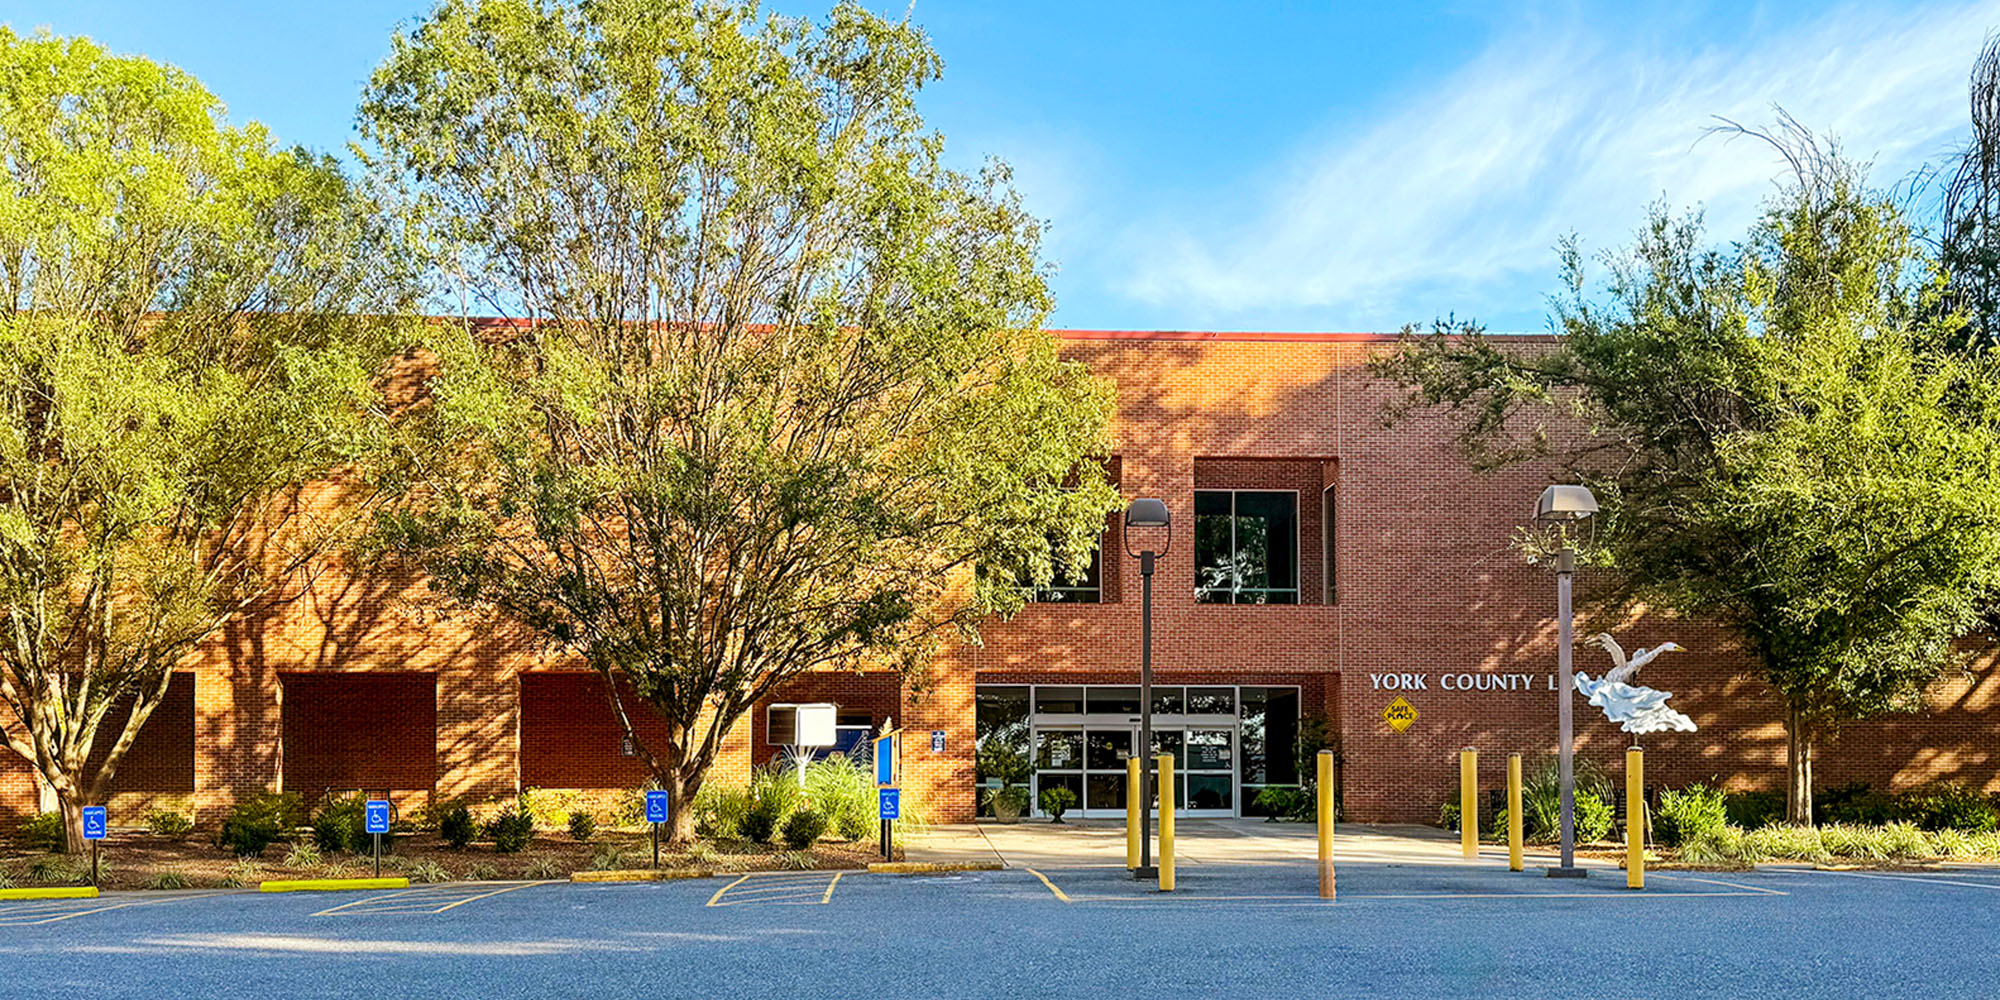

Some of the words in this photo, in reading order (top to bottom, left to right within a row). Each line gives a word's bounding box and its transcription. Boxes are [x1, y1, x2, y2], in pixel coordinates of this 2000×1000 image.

[1370, 673, 1428, 690] YORK
[1440, 673, 1535, 691] COUNTY
[1391, 705, 1409, 713] SAFE
